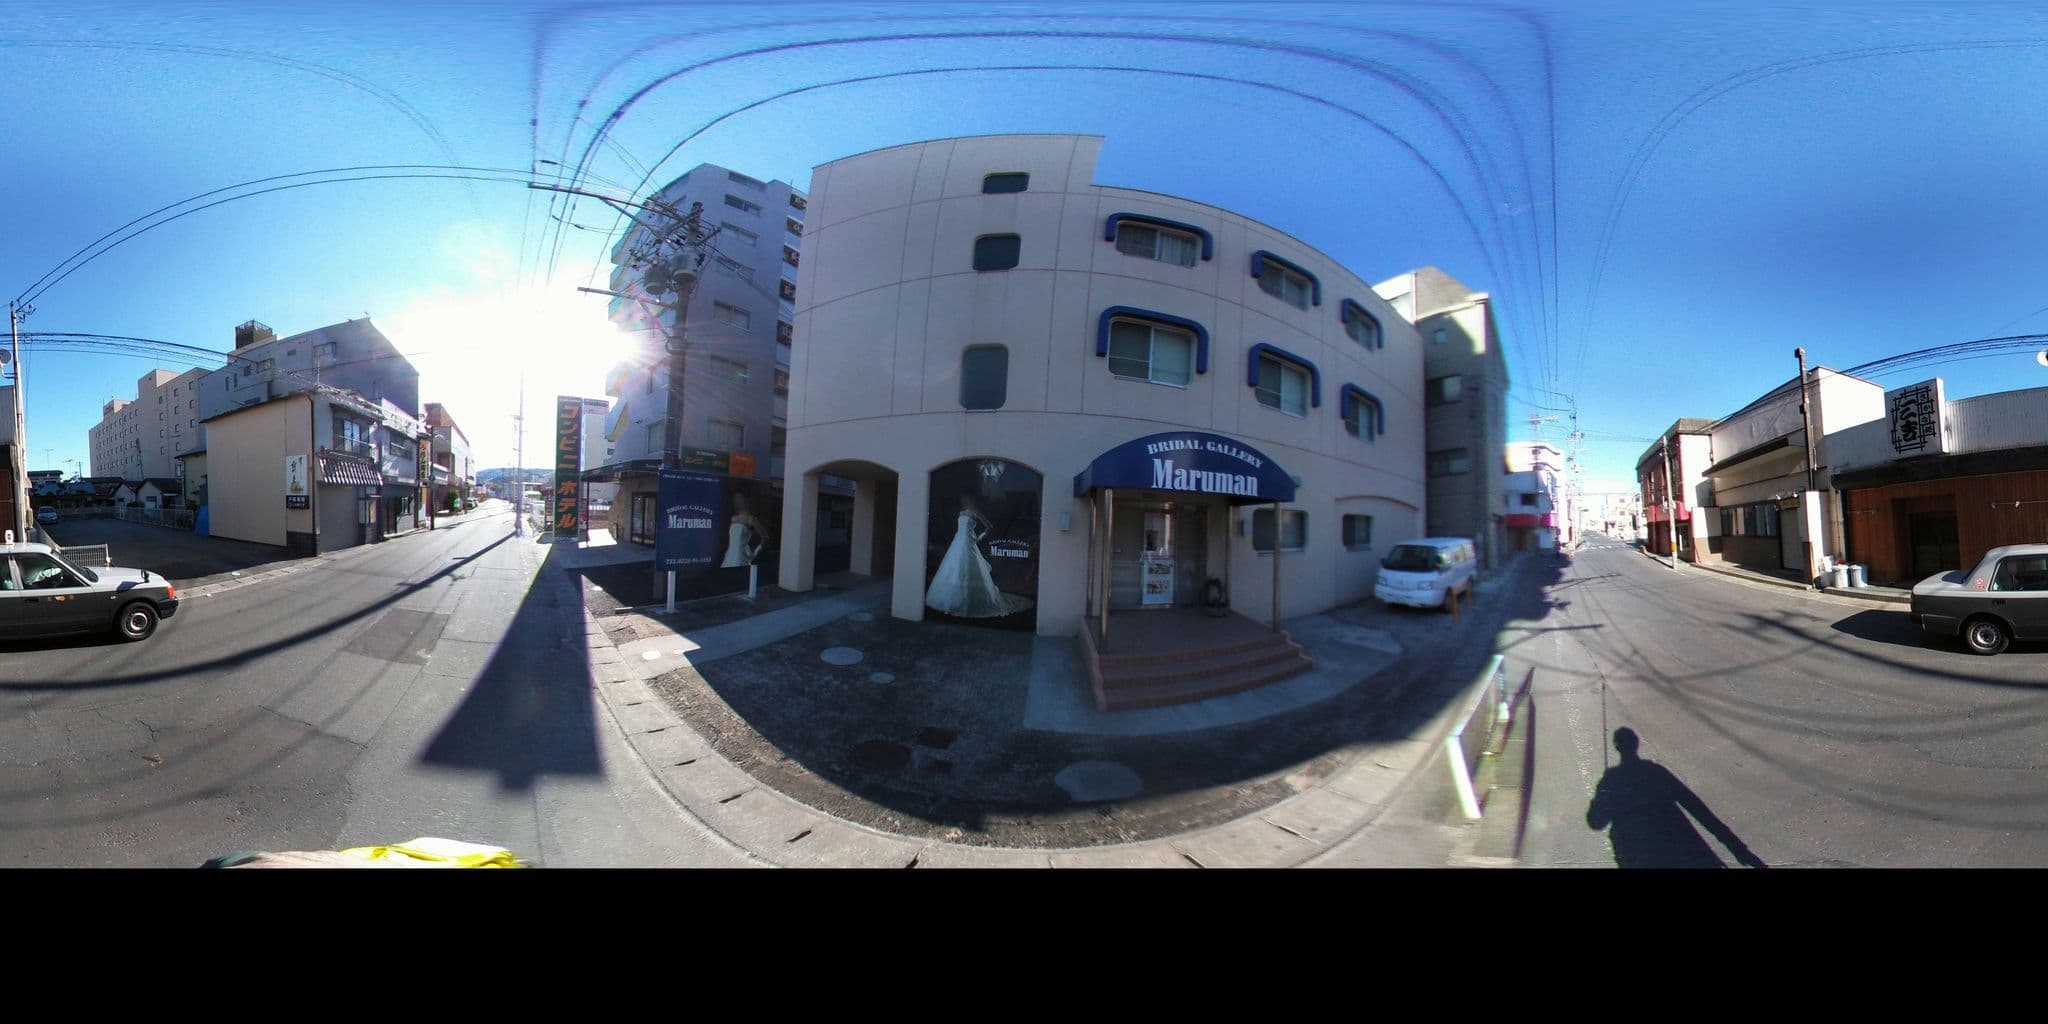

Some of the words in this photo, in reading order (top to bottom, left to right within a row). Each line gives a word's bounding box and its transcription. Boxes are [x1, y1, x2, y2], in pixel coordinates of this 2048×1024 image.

[559, 404, 580, 469] コンビニ
[1146, 439, 1204, 455] BRIDAL
[1206, 441, 1264, 469] GALLERY
[1151, 458, 1258, 497] Maruman
[555, 480, 577, 529] ホテル
[667, 514, 713, 529] Maruman
[990, 545, 1029, 559] Maruman
